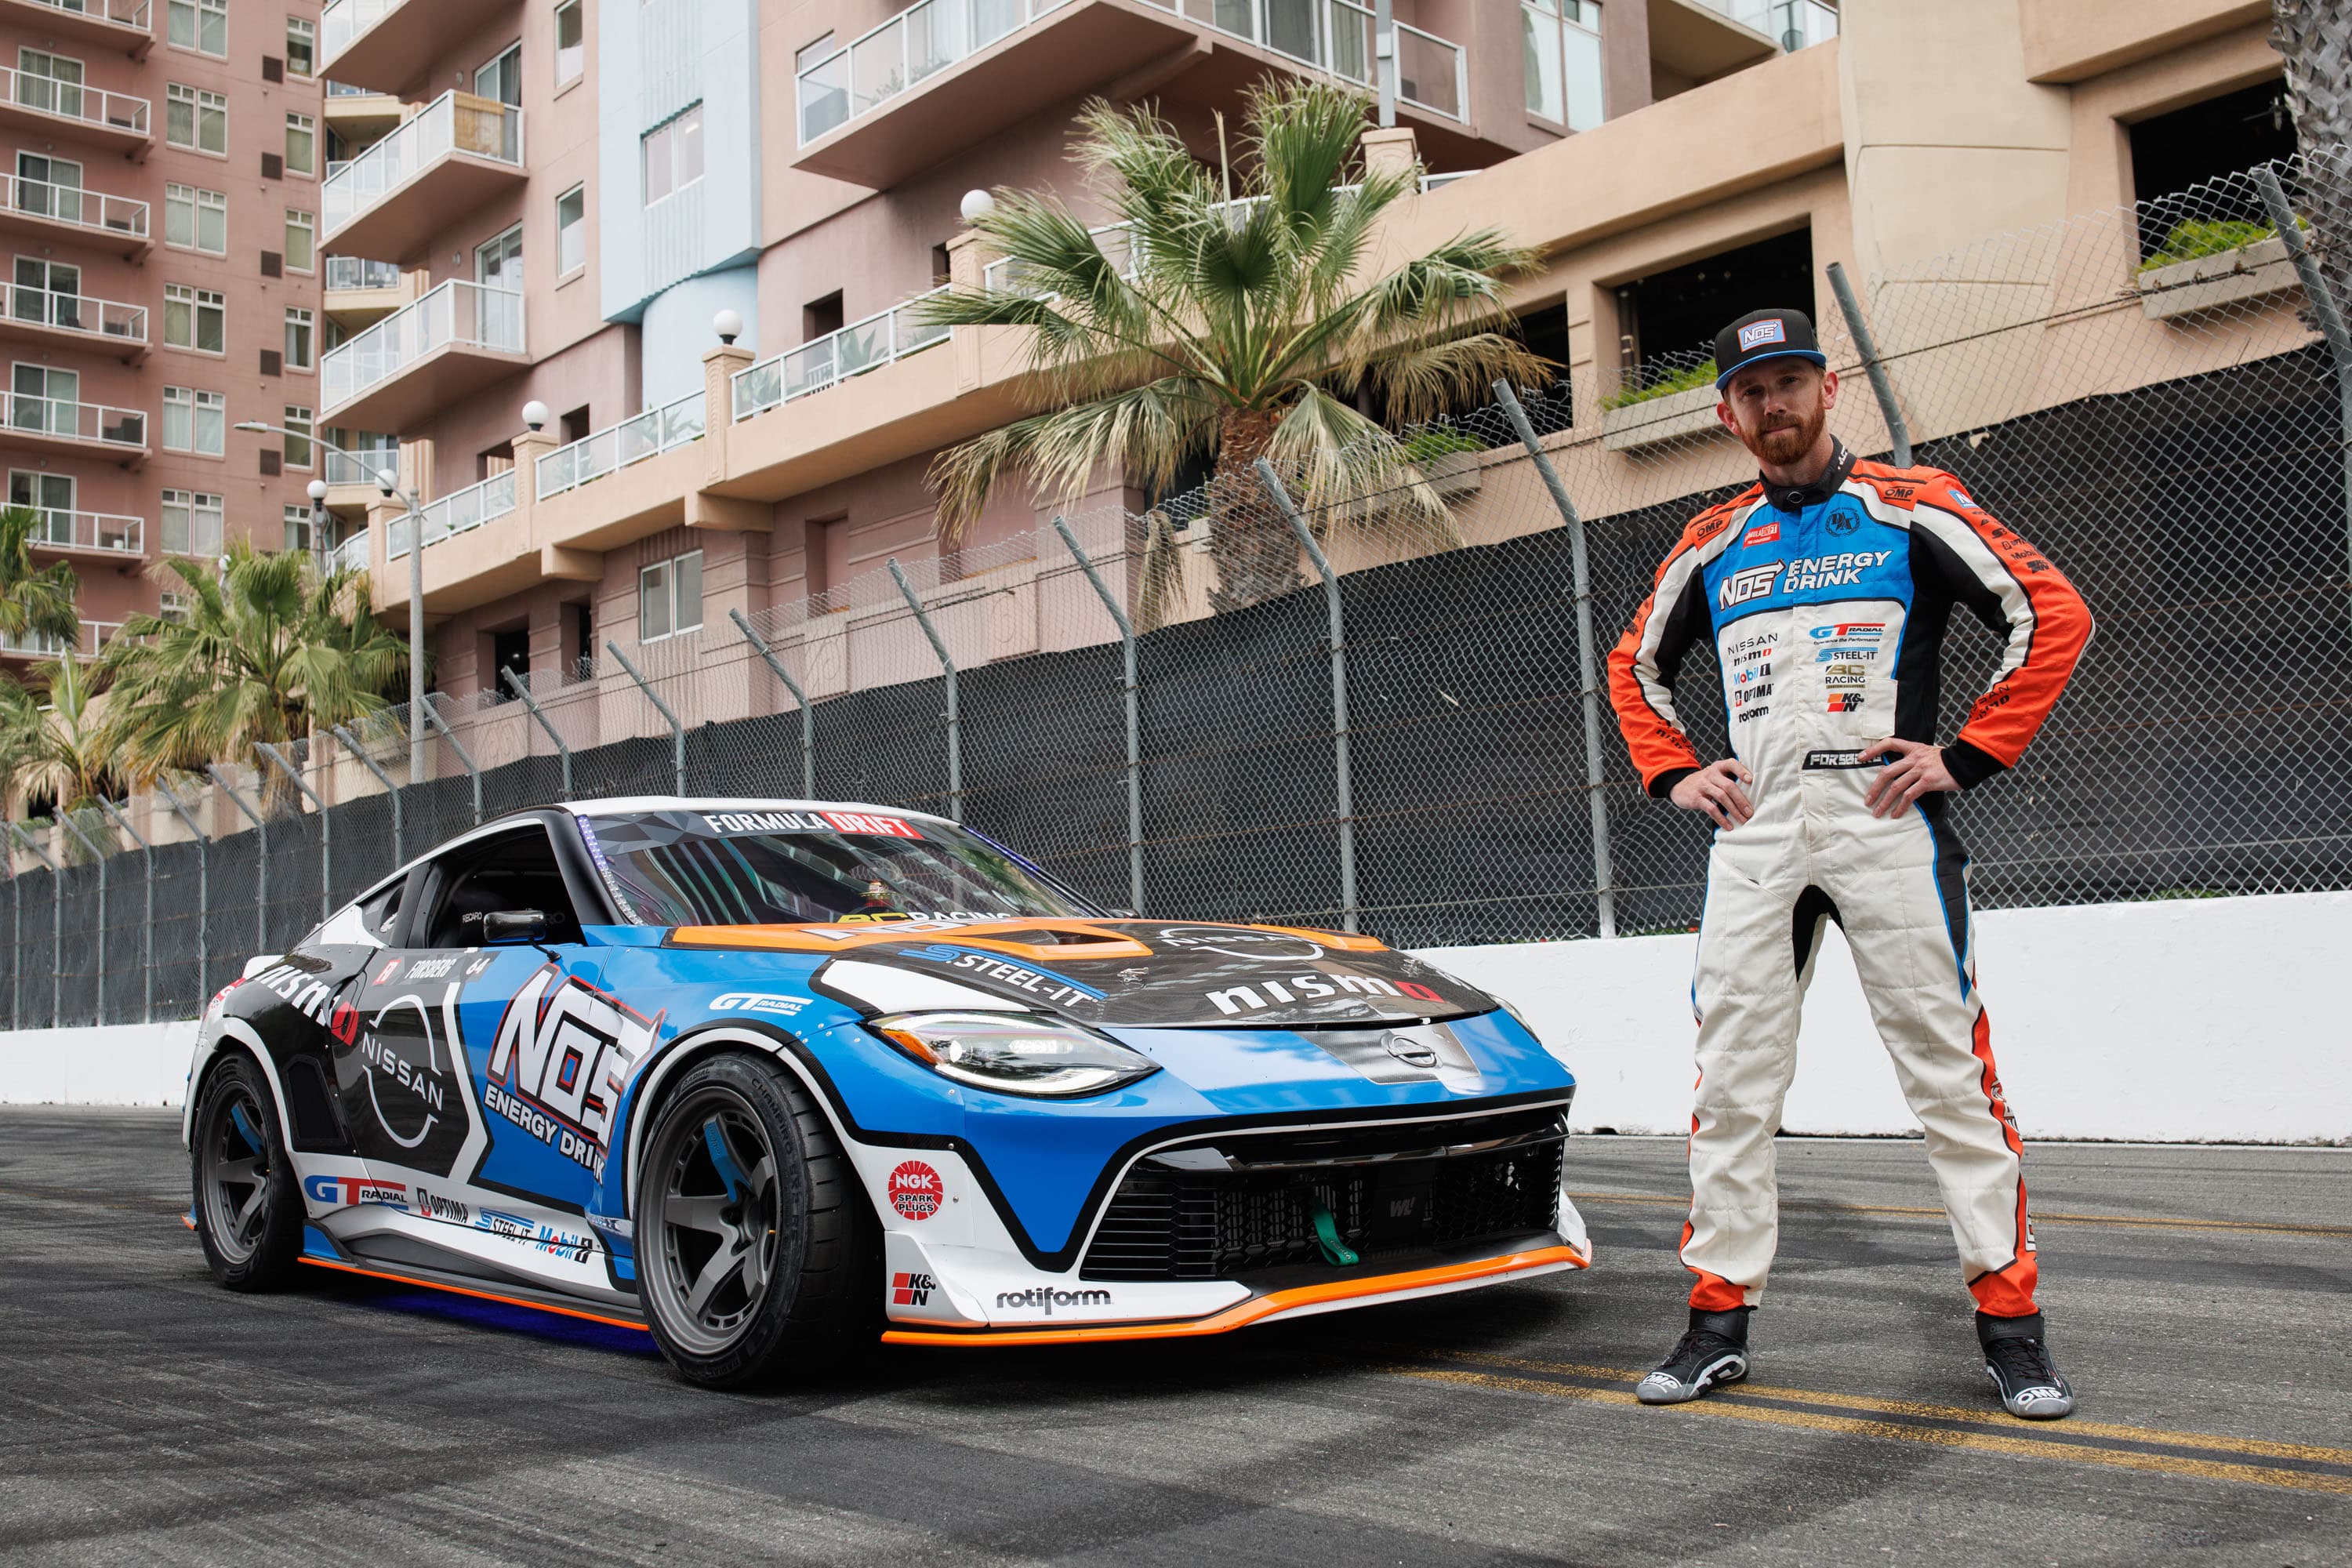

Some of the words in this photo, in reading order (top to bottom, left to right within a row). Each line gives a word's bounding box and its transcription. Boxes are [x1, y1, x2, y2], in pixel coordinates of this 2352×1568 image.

[1744, 322, 1778, 345] NOS
[1885, 488, 1914, 498] OMP
[1697, 519, 1723, 537] OMP
[1787, 550, 1893, 577] ENERGY
[1718, 558, 1787, 612] NOS
[1781, 567, 1864, 594] DRINK
[1727, 633, 1779, 656] NISSAN
[1833, 651, 1876, 660] STEEL-IT
[1733, 648, 1773, 666] nismo
[1733, 666, 1759, 686] Mobil
[1759, 662, 1771, 677] 1
[1825, 676, 1866, 684] RACING
[1826, 664, 1865, 676] BC
[704, 812, 833, 835] FORMULA
[836, 814, 912, 838] DRIFT
[462, 911, 483, 924] RECARO
[1161, 935, 1319, 947] NISSAN
[405, 958, 458, 979] FORSBERG
[465, 957, 492, 975] 64
[953, 954, 1088, 1008] STEEL-IT
[254, 964, 360, 1047] nismo
[757, 998, 804, 1013] RADIAL
[1205, 973, 1447, 1016] nismo
[362, 1030, 444, 1112] NISSAN
[487, 962, 665, 1158] NOS
[484, 1080, 560, 1146] ENERGY
[895, 1174, 934, 1190] NGK
[361, 1189, 408, 1203] RADIAL
[898, 1193, 934, 1203] SPARK
[430, 1196, 469, 1224] OPTIMA
[898, 1203, 935, 1213] PLUGS
[535, 1225, 579, 1261] Mobil
[908, 1273, 937, 1306] K&N
[996, 1287, 1112, 1316] rotiform
[1704, 1316, 1726, 1326] OMP
[1642, 1374, 1679, 1389] OMP
[2016, 1388, 2063, 1406] OMP
